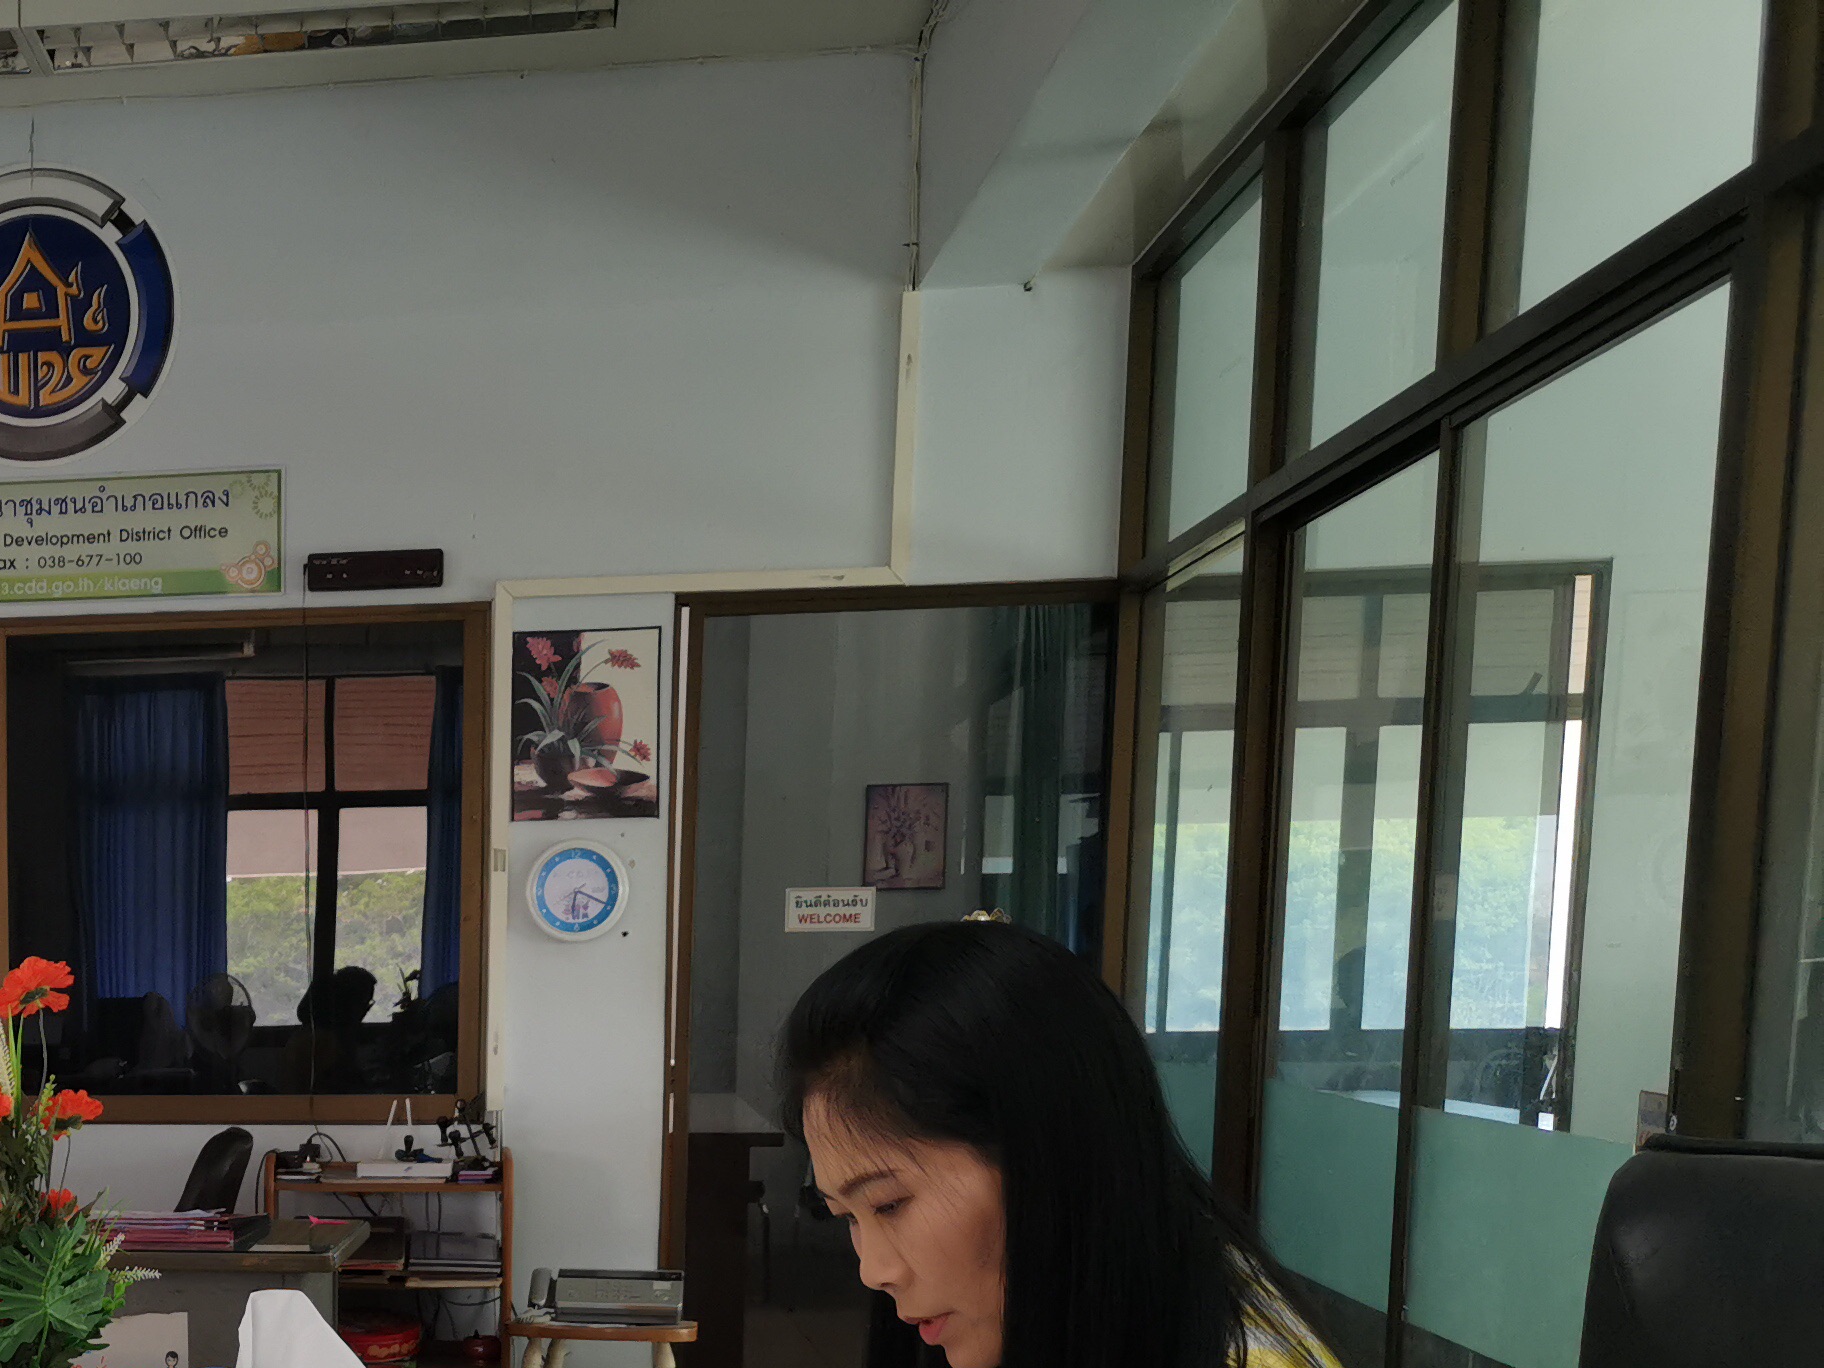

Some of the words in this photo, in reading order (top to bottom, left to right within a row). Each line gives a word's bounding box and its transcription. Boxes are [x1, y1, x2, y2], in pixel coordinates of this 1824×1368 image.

[3, 529, 111, 548] Development
[119, 525, 172, 543] District
[179, 523, 229, 540] Office
[37, 551, 143, 569] 038-677-100
[794, 894, 869, 908] ยินดีต้อนรับ
[797, 912, 863, 925] WELCOME
